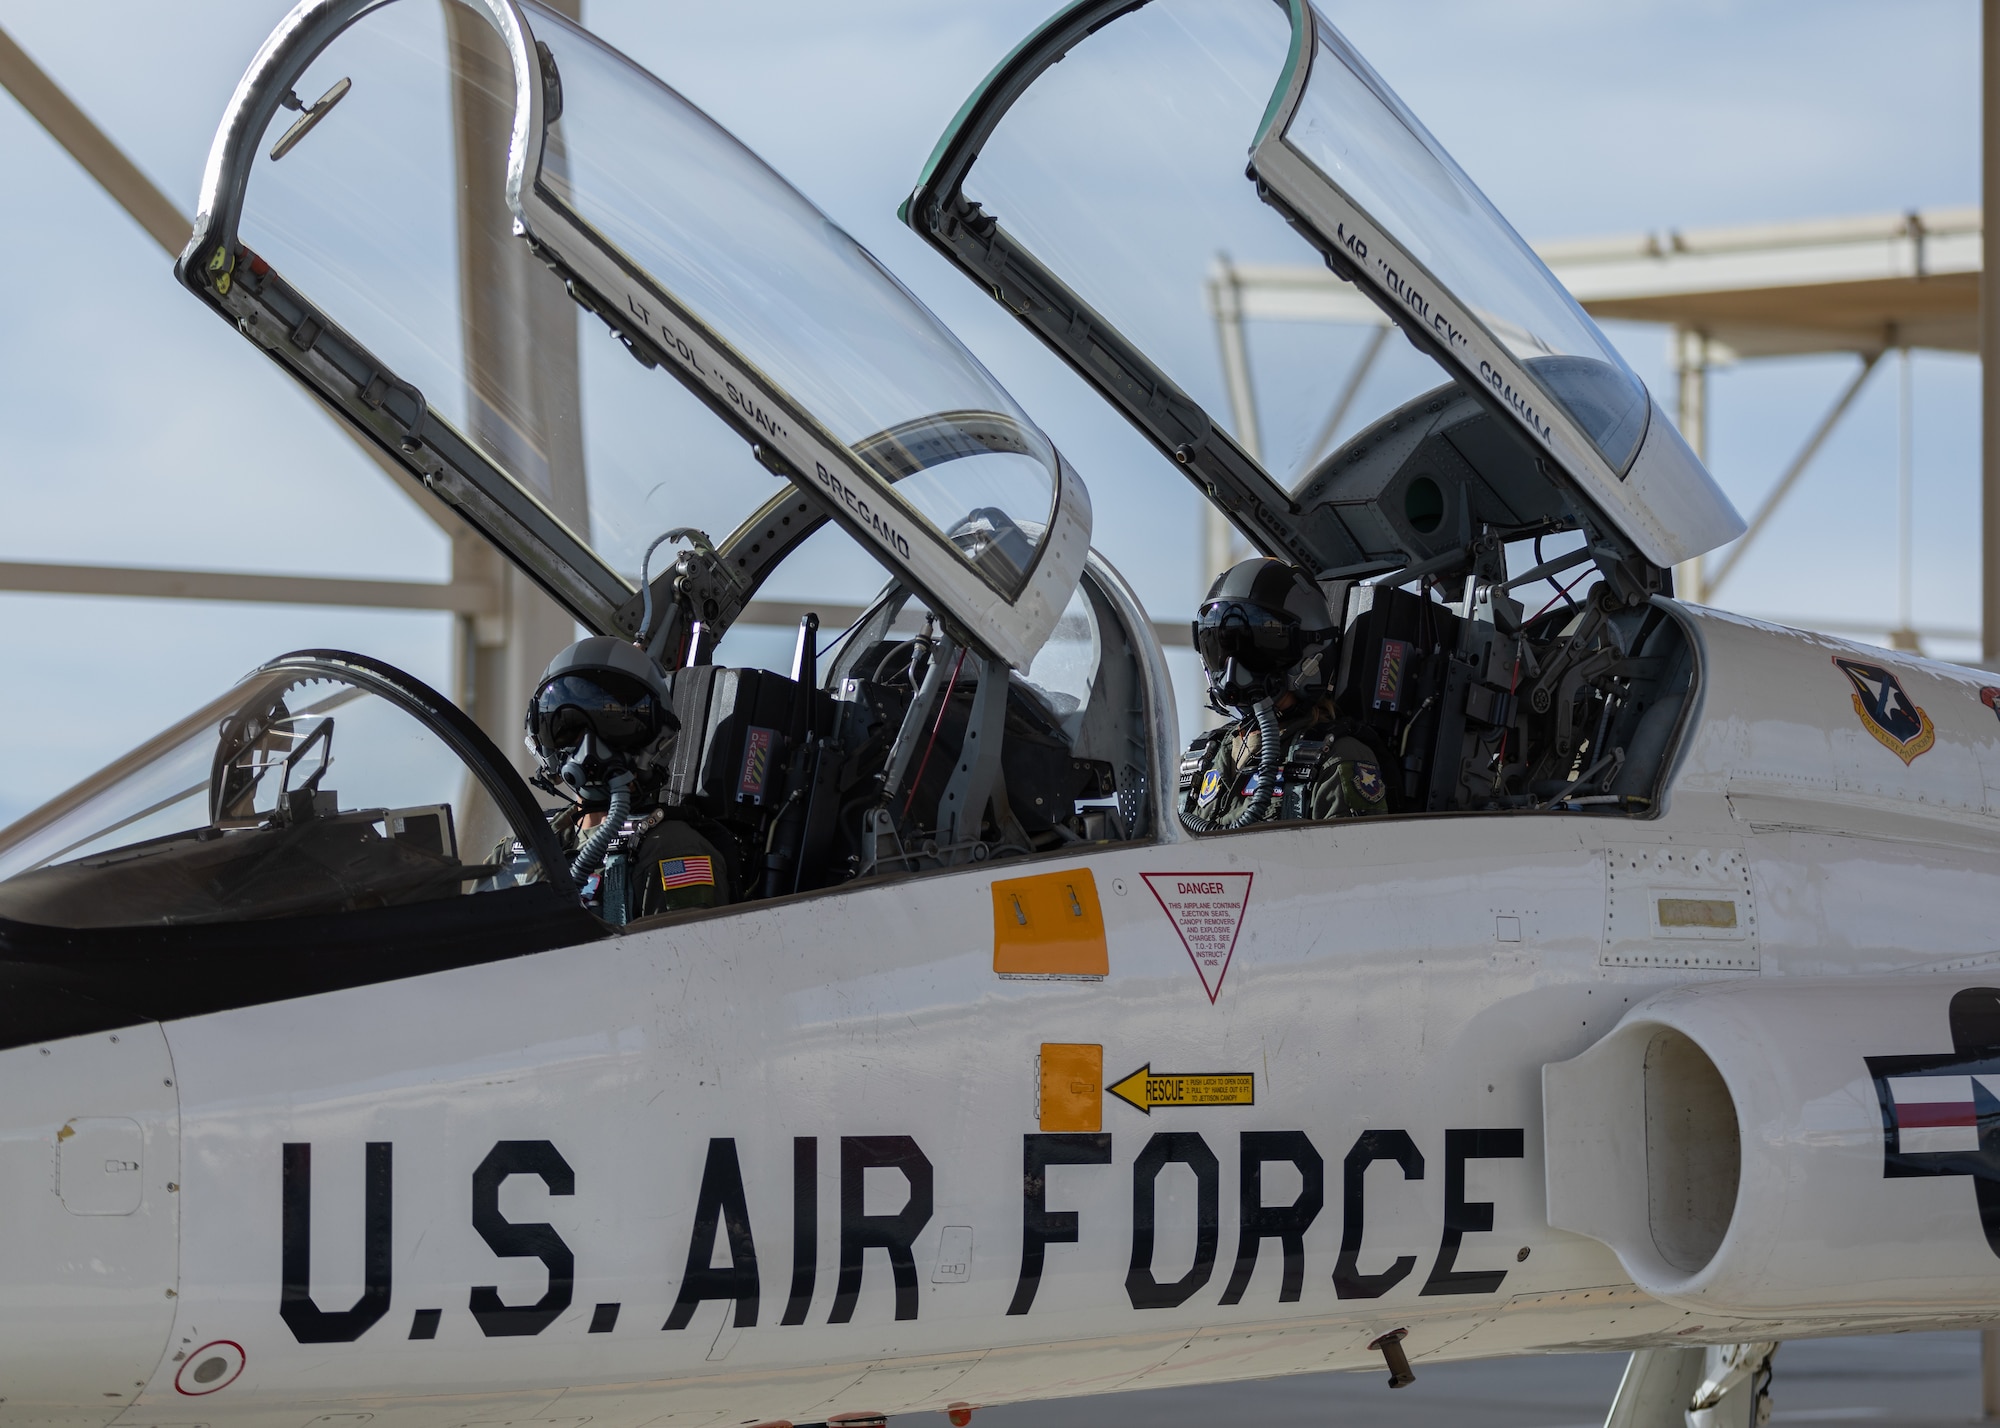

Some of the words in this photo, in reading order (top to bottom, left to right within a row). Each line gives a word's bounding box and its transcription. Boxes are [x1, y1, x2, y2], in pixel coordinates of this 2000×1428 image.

[1337, 223, 1368, 265] MR
[1479, 360, 1551, 444] GRAHAM
[627, 294, 650, 326] LT
[661, 325, 706, 376] COL
[713, 369, 788, 438] "SUAV"
[1380, 644, 1393, 691] DANGER
[744, 732, 759, 783] DANGER
[1177, 882, 1225, 894] DANGER
[1211, 910, 1230, 918] SEATS,
[1145, 1079, 1184, 1102] RESCUE
[279, 1140, 621, 1344] U.S.
[662, 1136, 934, 1331] AIR
[1006, 1128, 1524, 1316] FORCE
